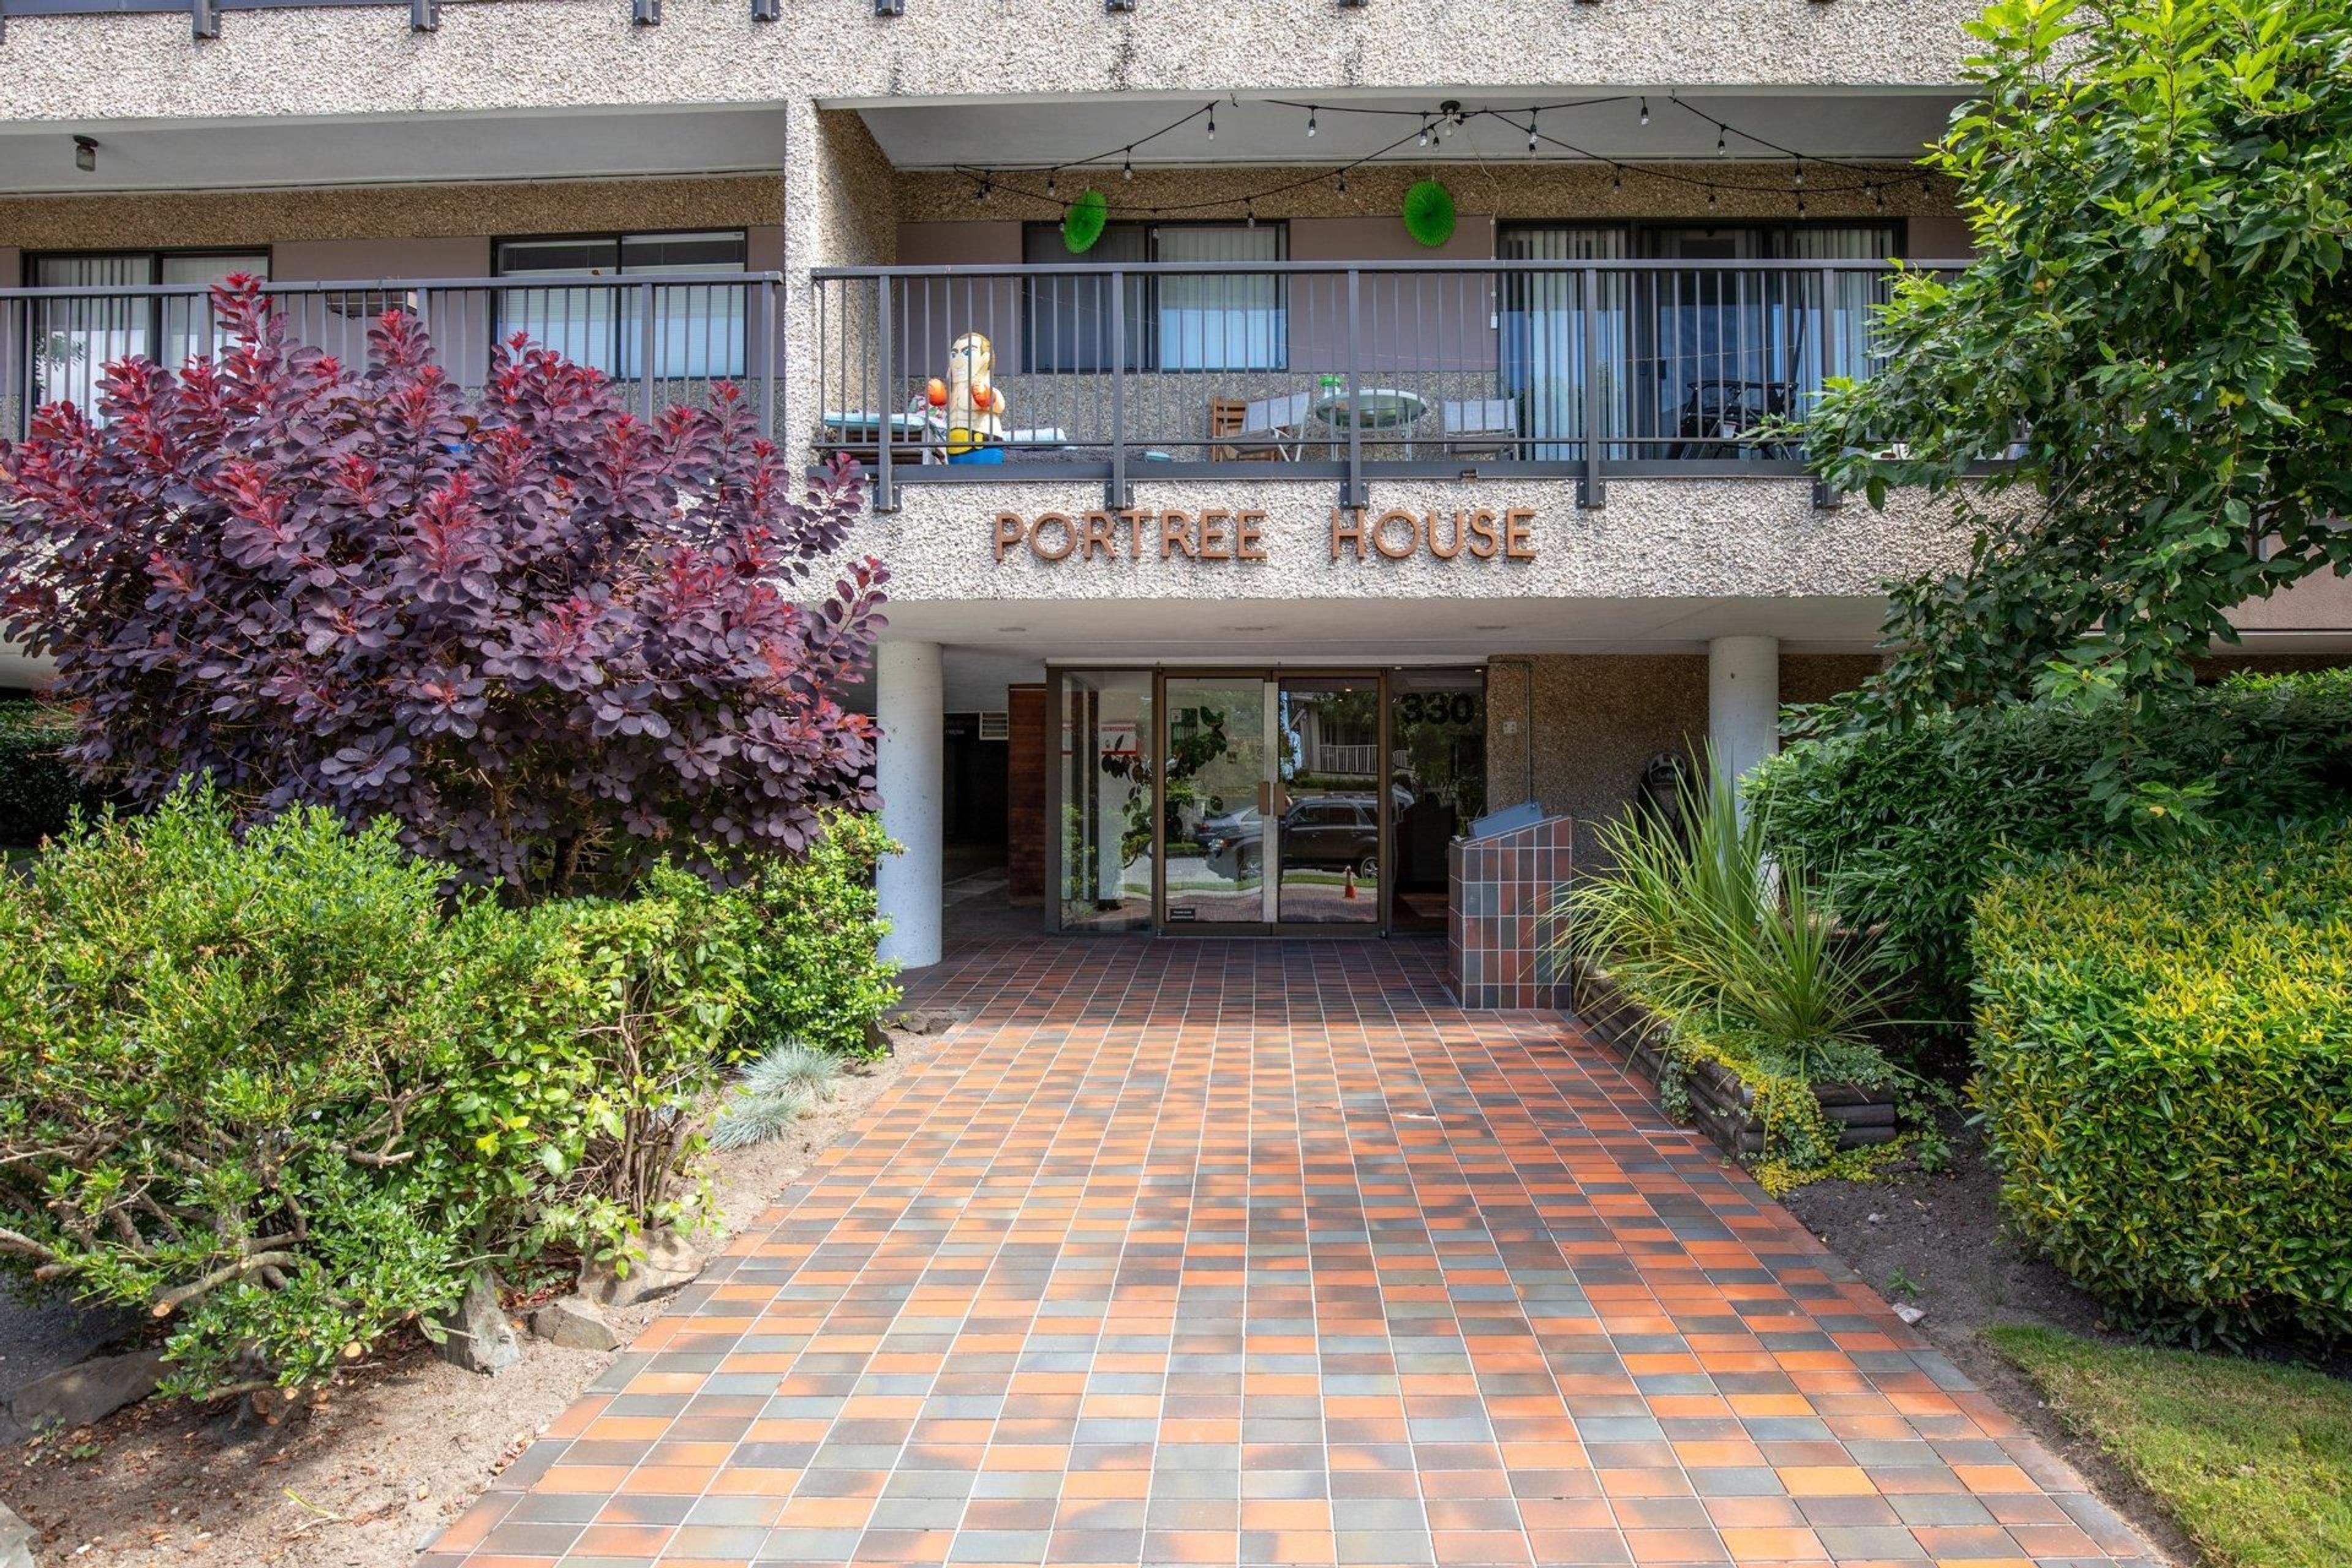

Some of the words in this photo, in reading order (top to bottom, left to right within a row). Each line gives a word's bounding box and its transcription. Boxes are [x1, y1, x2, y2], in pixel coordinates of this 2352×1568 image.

[994, 509, 1267, 560] PORTREE
[1332, 507, 1537, 559] HOUSE
[1401, 693, 1474, 725] 330
